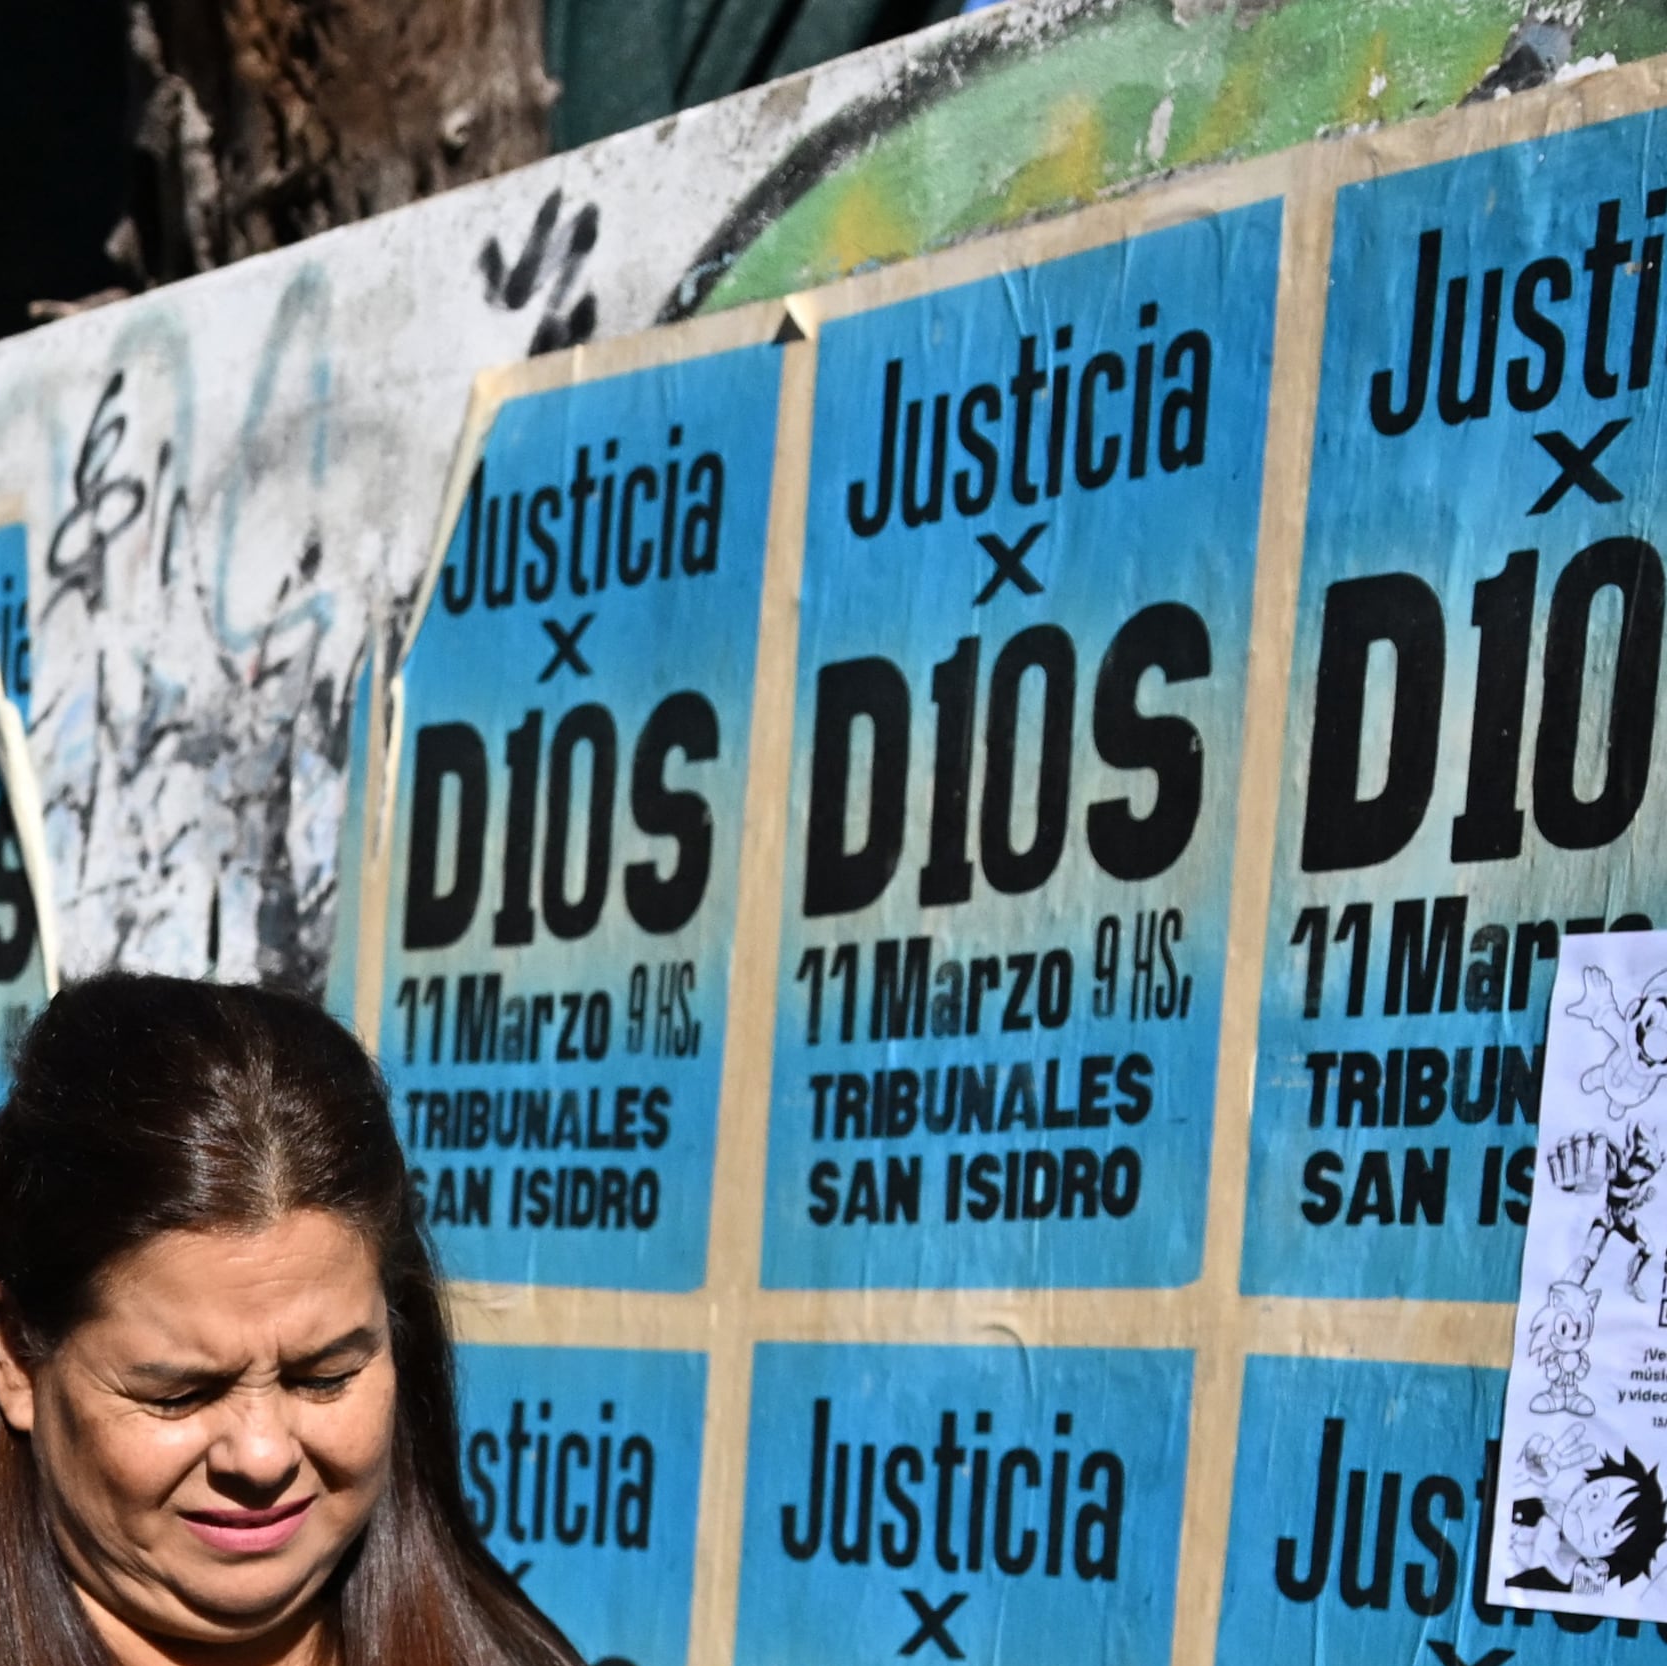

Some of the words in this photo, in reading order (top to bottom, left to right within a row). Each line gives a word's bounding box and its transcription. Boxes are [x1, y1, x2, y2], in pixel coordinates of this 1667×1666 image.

[1370, 188, 1667, 437] Justi
[847, 302, 1212, 538] Justicia
[442, 425, 724, 616] Justicia
[1302, 536, 1666, 873] D10
[395, 972, 446, 1068] 11
[454, 966, 611, 1066] Marzo
[627, 961, 649, 1052] 9
[796, 943, 859, 1046] 11
[864, 935, 1074, 1042] Marzo
[1092, 914, 1121, 1019] 9
[1289, 903, 1372, 1019] 11
[1384, 897, 1654, 1017] Mar
[407, 1086, 671, 1150] TRIBUNALES
[809, 1054, 1153, 1141] TRIBUNALES
[1304, 1045, 1543, 1128] TRIBUN
[406, 1167, 492, 1227] SAN
[510, 1167, 660, 1231] ISIDRO
[808, 1154, 921, 1228] SAN
[944, 1147, 1142, 1224] ISIDRO
[1301, 1147, 1450, 1226] SAN
[467, 1400, 655, 1551] sticia
[781, 1398, 1125, 1583] Justicia
